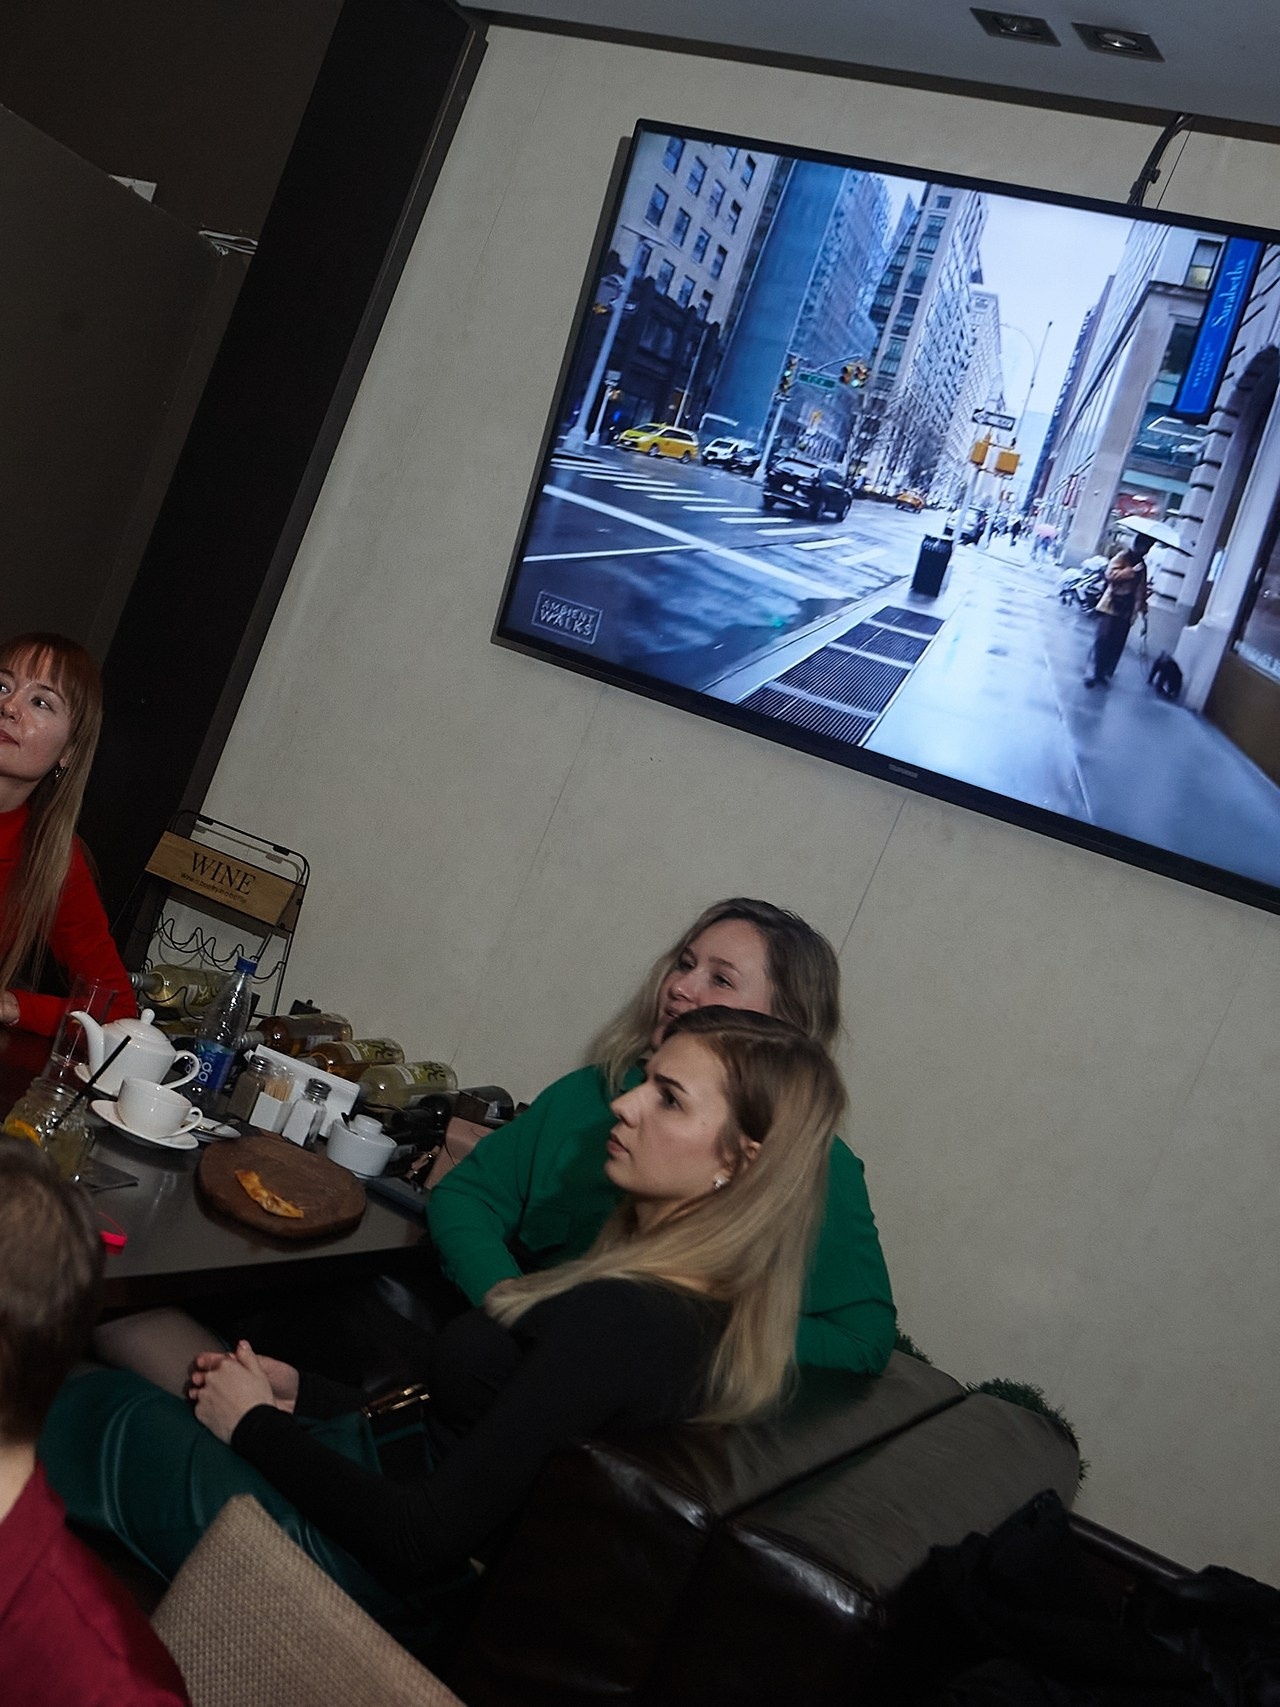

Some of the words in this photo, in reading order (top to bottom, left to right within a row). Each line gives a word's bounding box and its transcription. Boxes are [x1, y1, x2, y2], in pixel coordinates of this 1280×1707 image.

[540, 609, 592, 636] WALKS
[542, 599, 596, 622] AMBIENT
[192, 851, 256, 895] WINE
